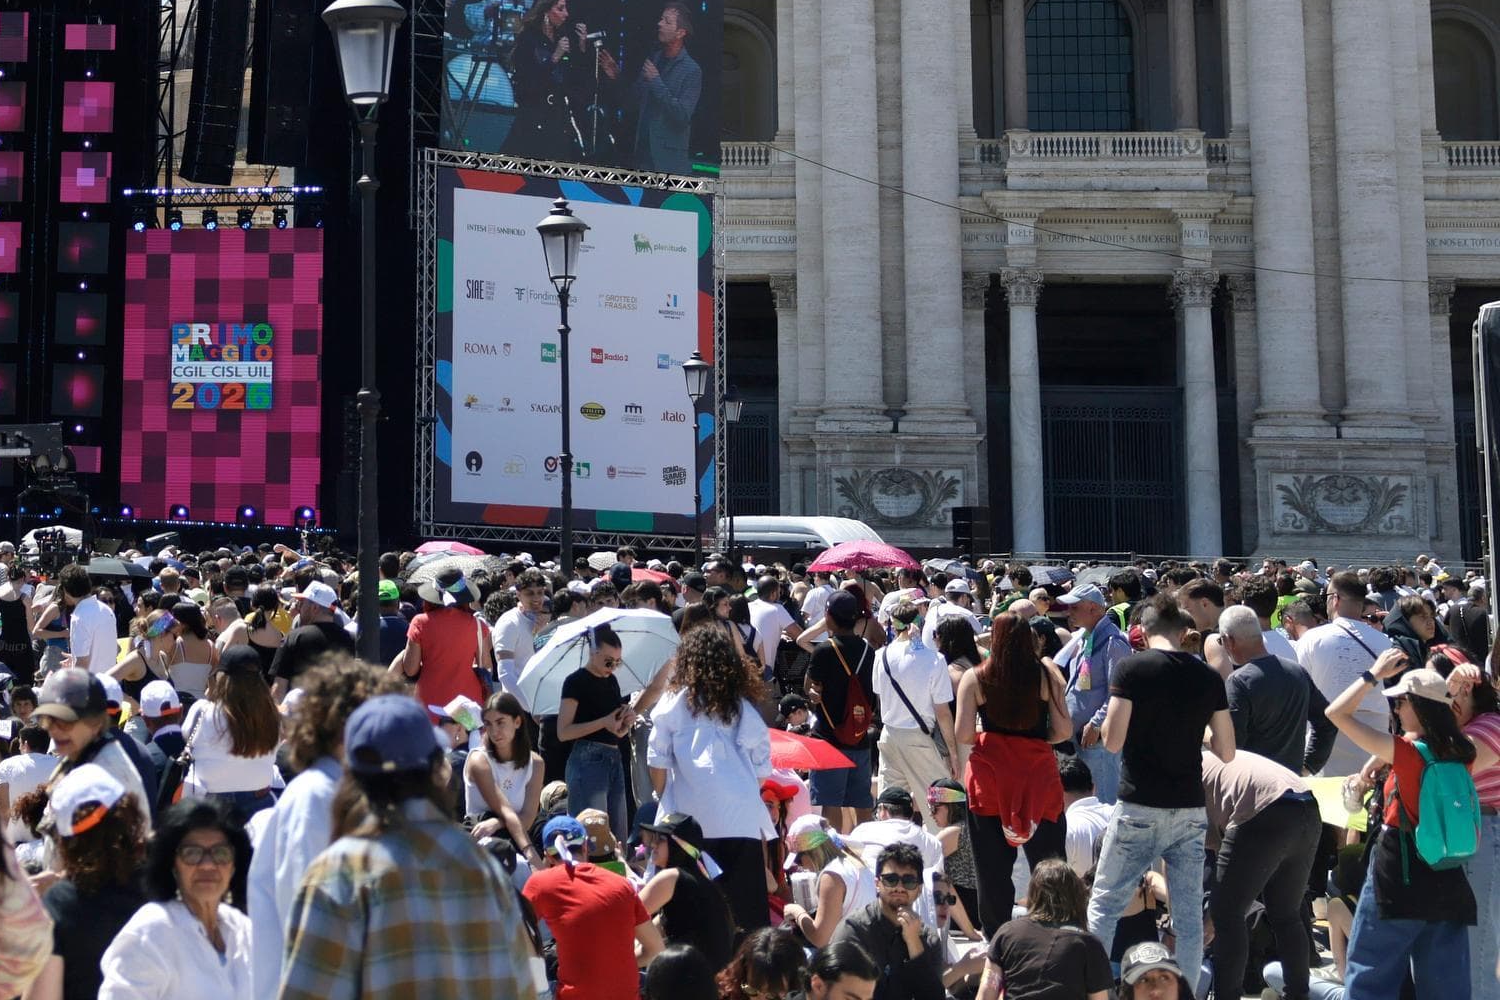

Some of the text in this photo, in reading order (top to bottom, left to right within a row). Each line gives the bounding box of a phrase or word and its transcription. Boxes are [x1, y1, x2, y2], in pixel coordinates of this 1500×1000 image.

[466, 279, 484, 300] SIAE
[172, 323, 274, 345] PRIMO
[172, 344, 273, 362] MAGGIO
[464, 342, 498, 356] ROMA
[542, 349, 555, 358] Rai
[173, 366, 271, 378] CGIL CISL UIL
[172, 382, 272, 409] 2026
